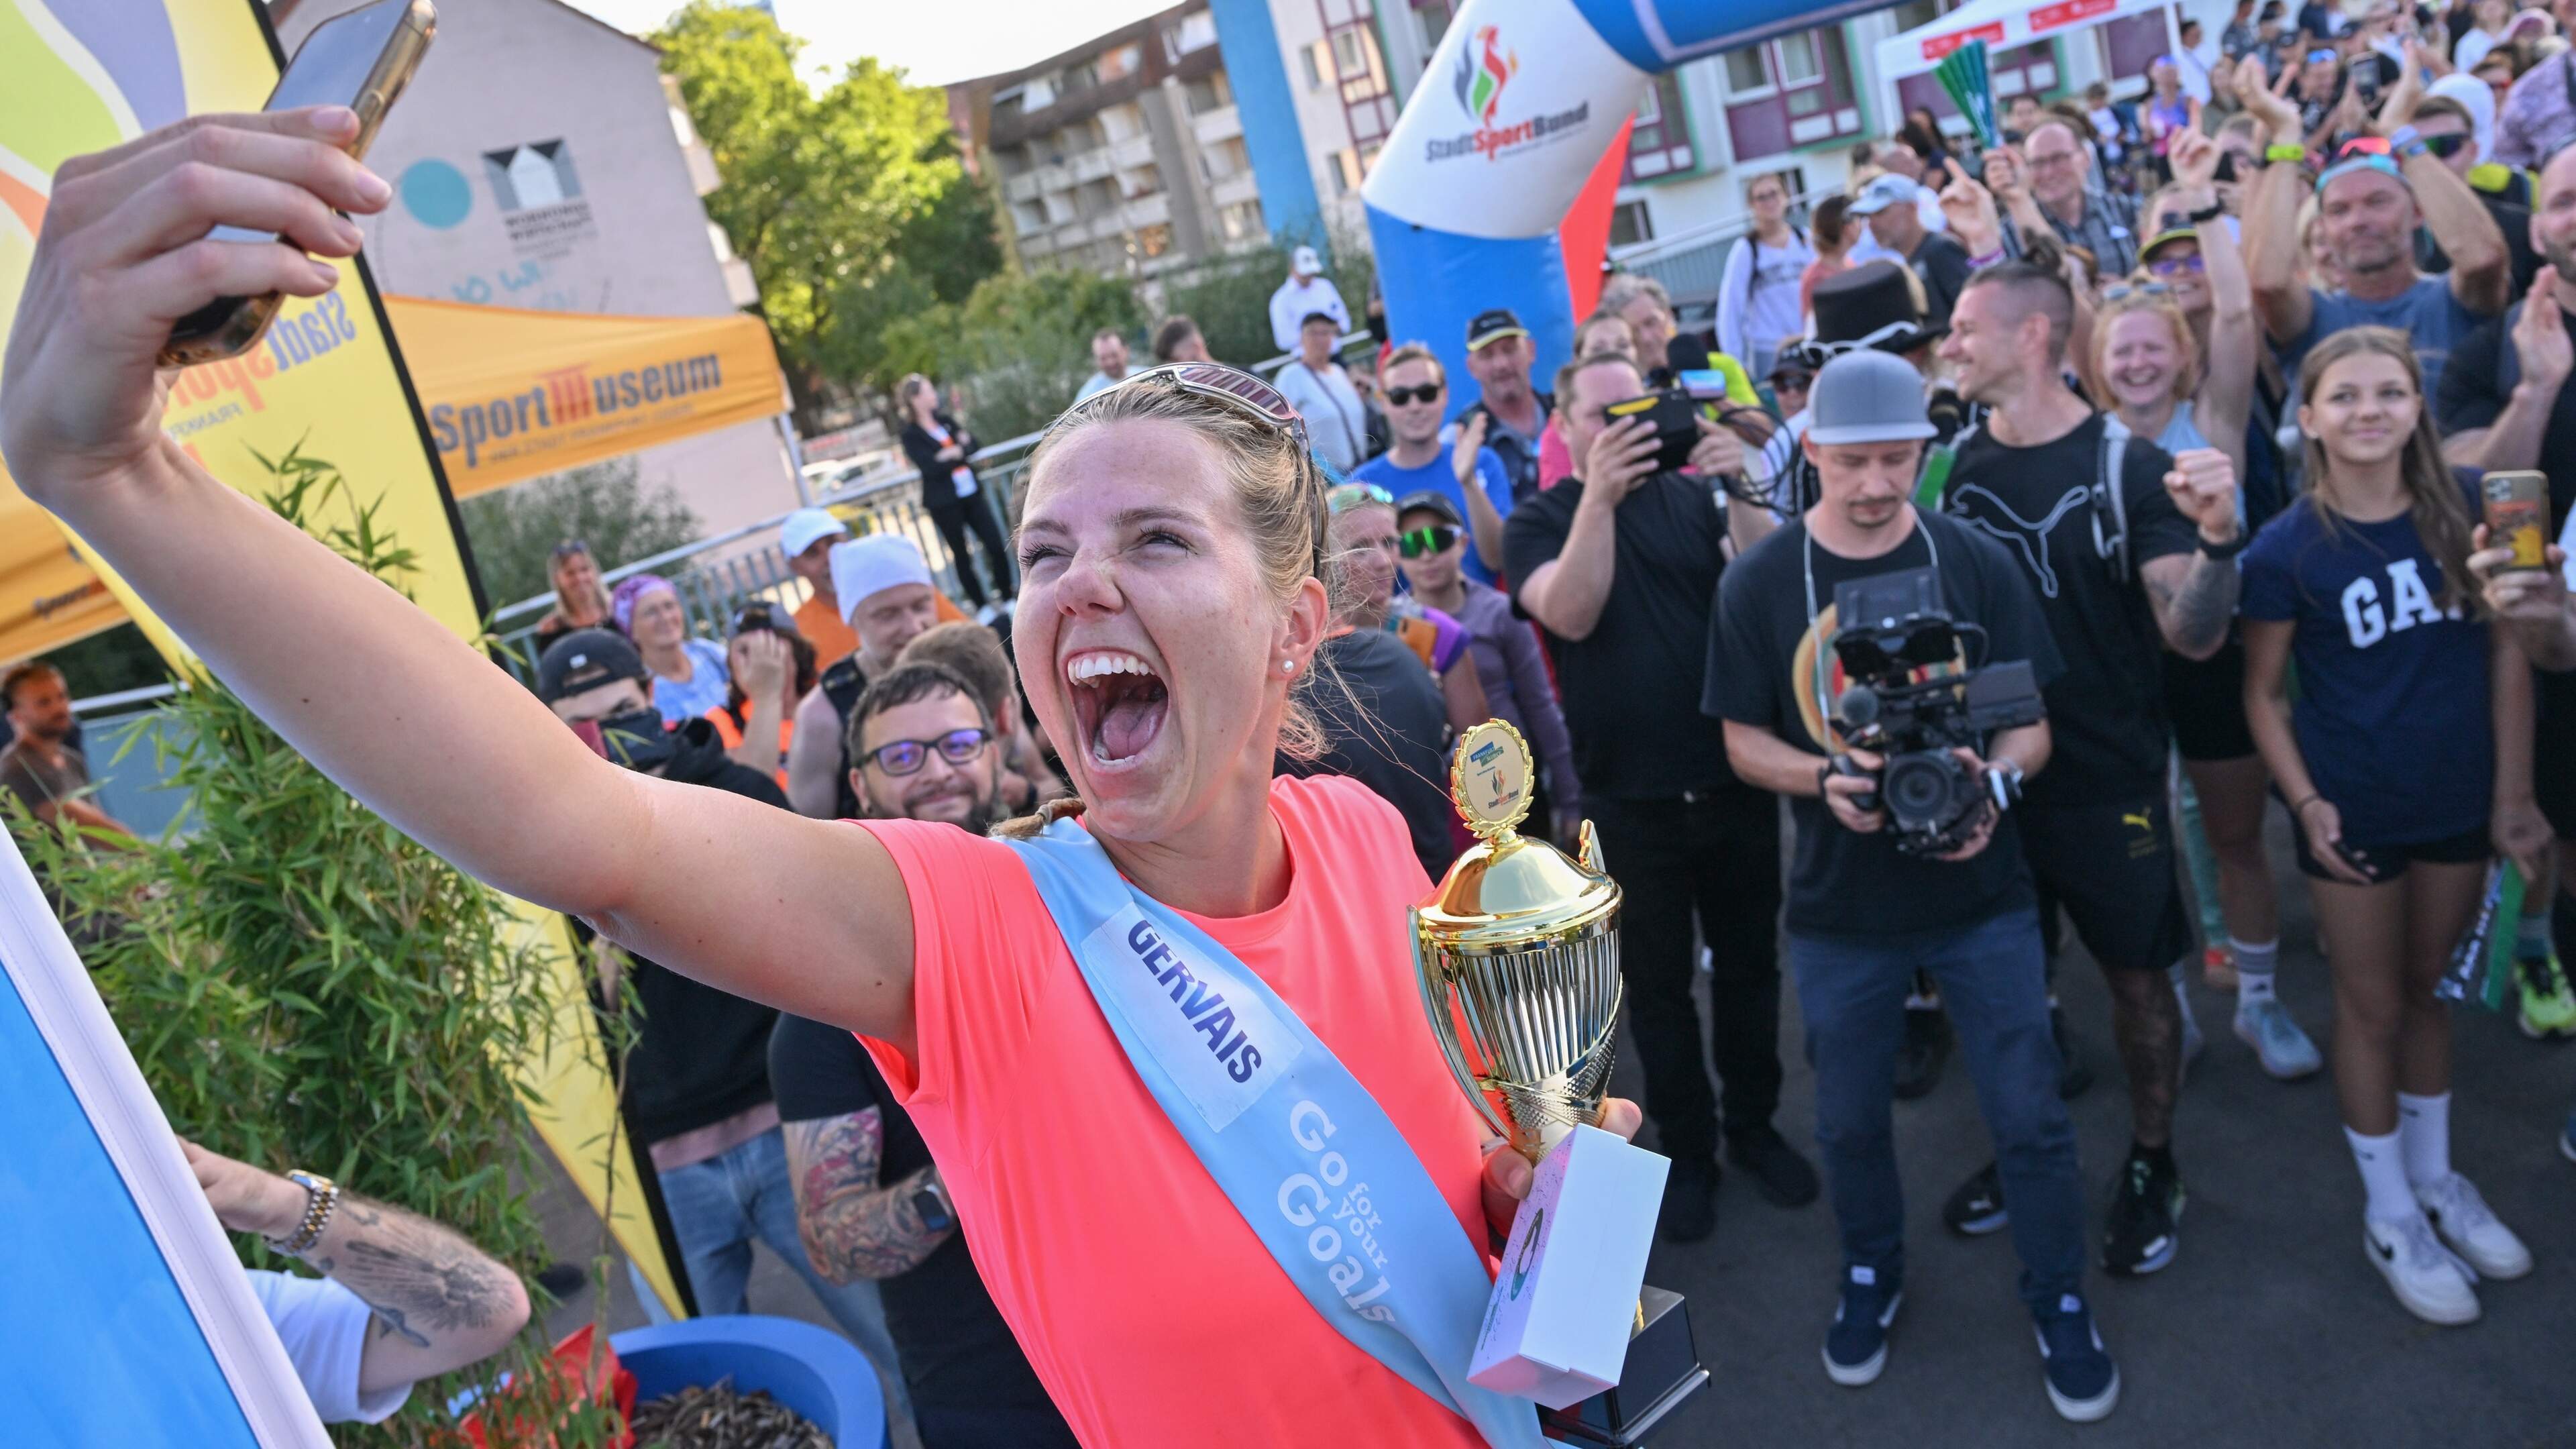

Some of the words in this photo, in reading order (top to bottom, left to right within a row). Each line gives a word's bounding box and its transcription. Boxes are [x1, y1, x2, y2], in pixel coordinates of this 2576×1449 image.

[2340, 556, 2463, 649] GA
[1128, 920, 1262, 1083] GERVAIS
[1289, 1099, 1348, 1187] Go
[1277, 1173, 1396, 1322] Goals
[1332, 1196, 1388, 1270] your
[1348, 1182, 1383, 1230] for
